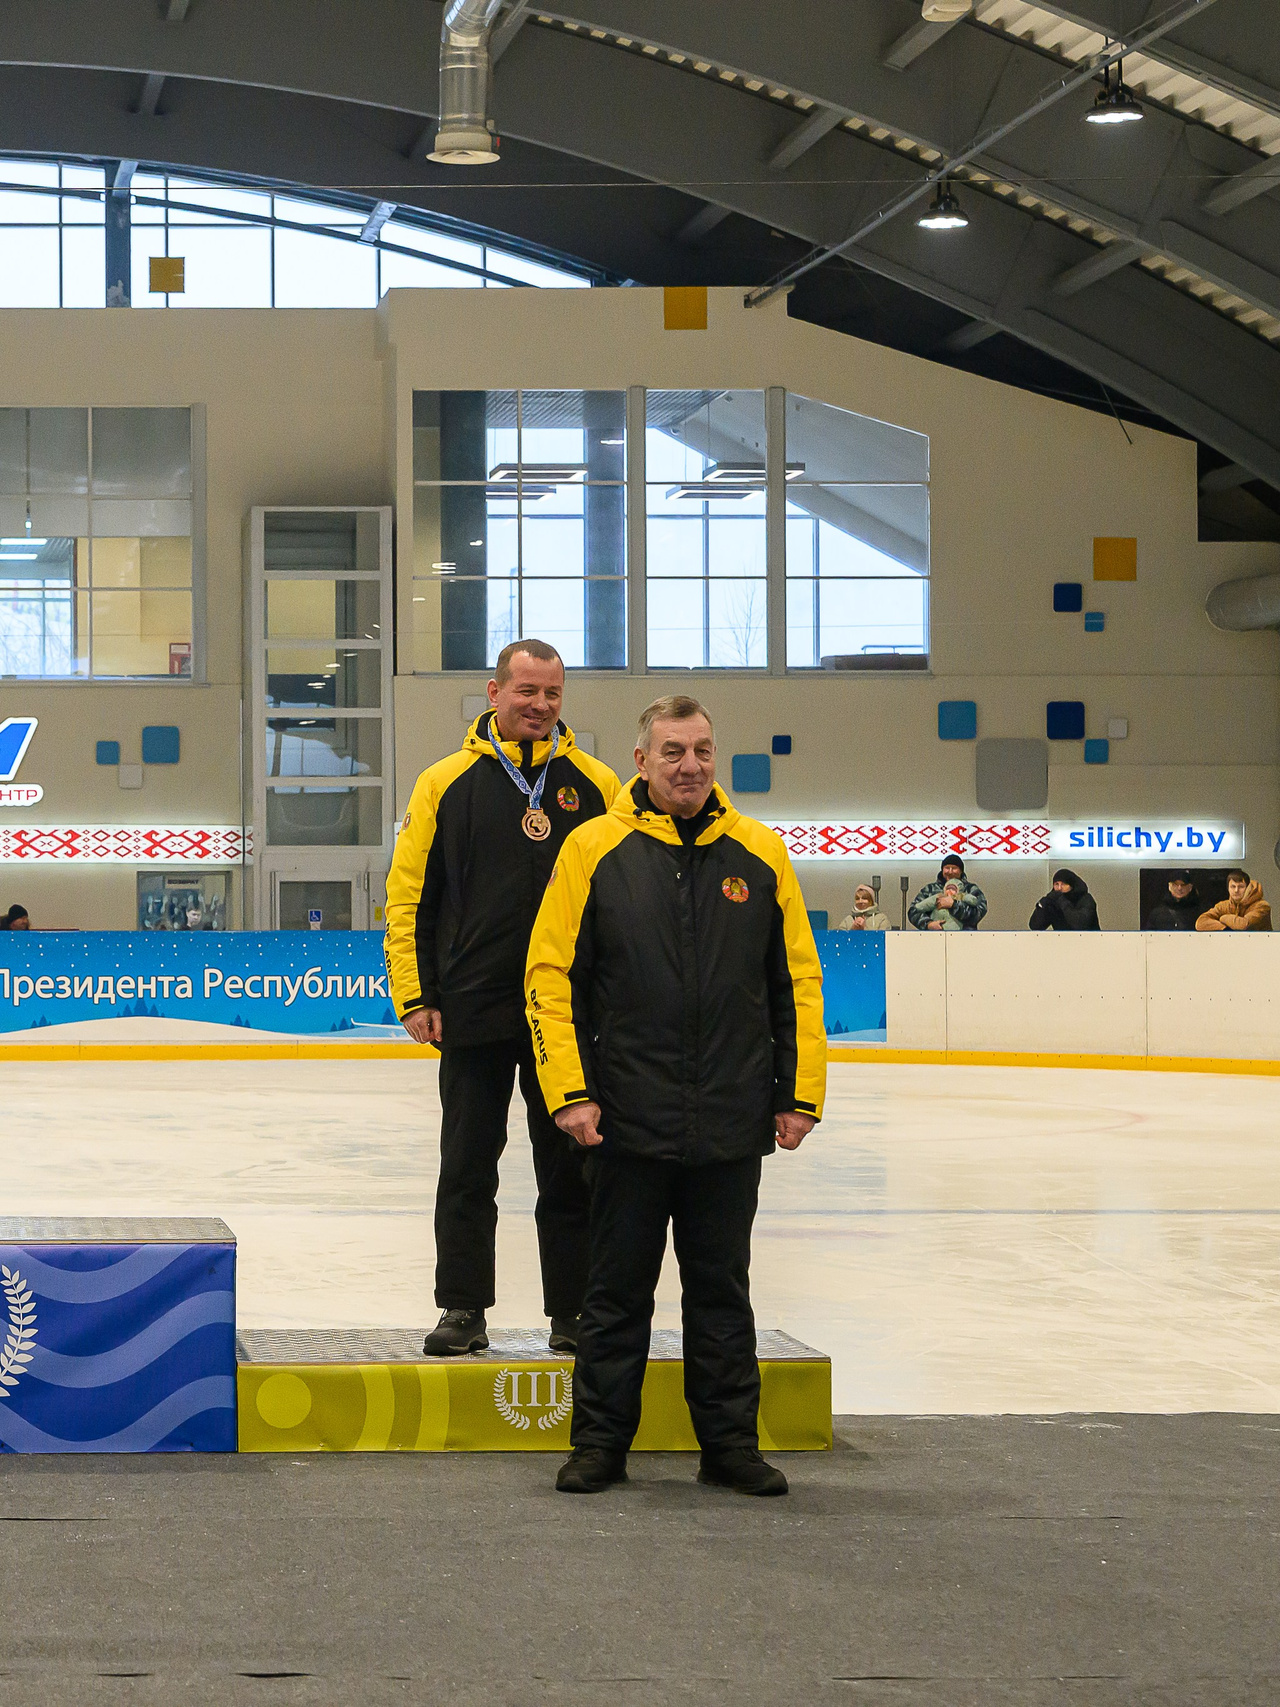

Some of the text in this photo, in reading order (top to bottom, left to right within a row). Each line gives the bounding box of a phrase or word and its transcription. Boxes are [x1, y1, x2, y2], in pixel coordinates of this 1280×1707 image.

[1069, 826, 1227, 853] silichy.by
[204, 967, 392, 1006] Республик
[507, 1371, 562, 1407] III
